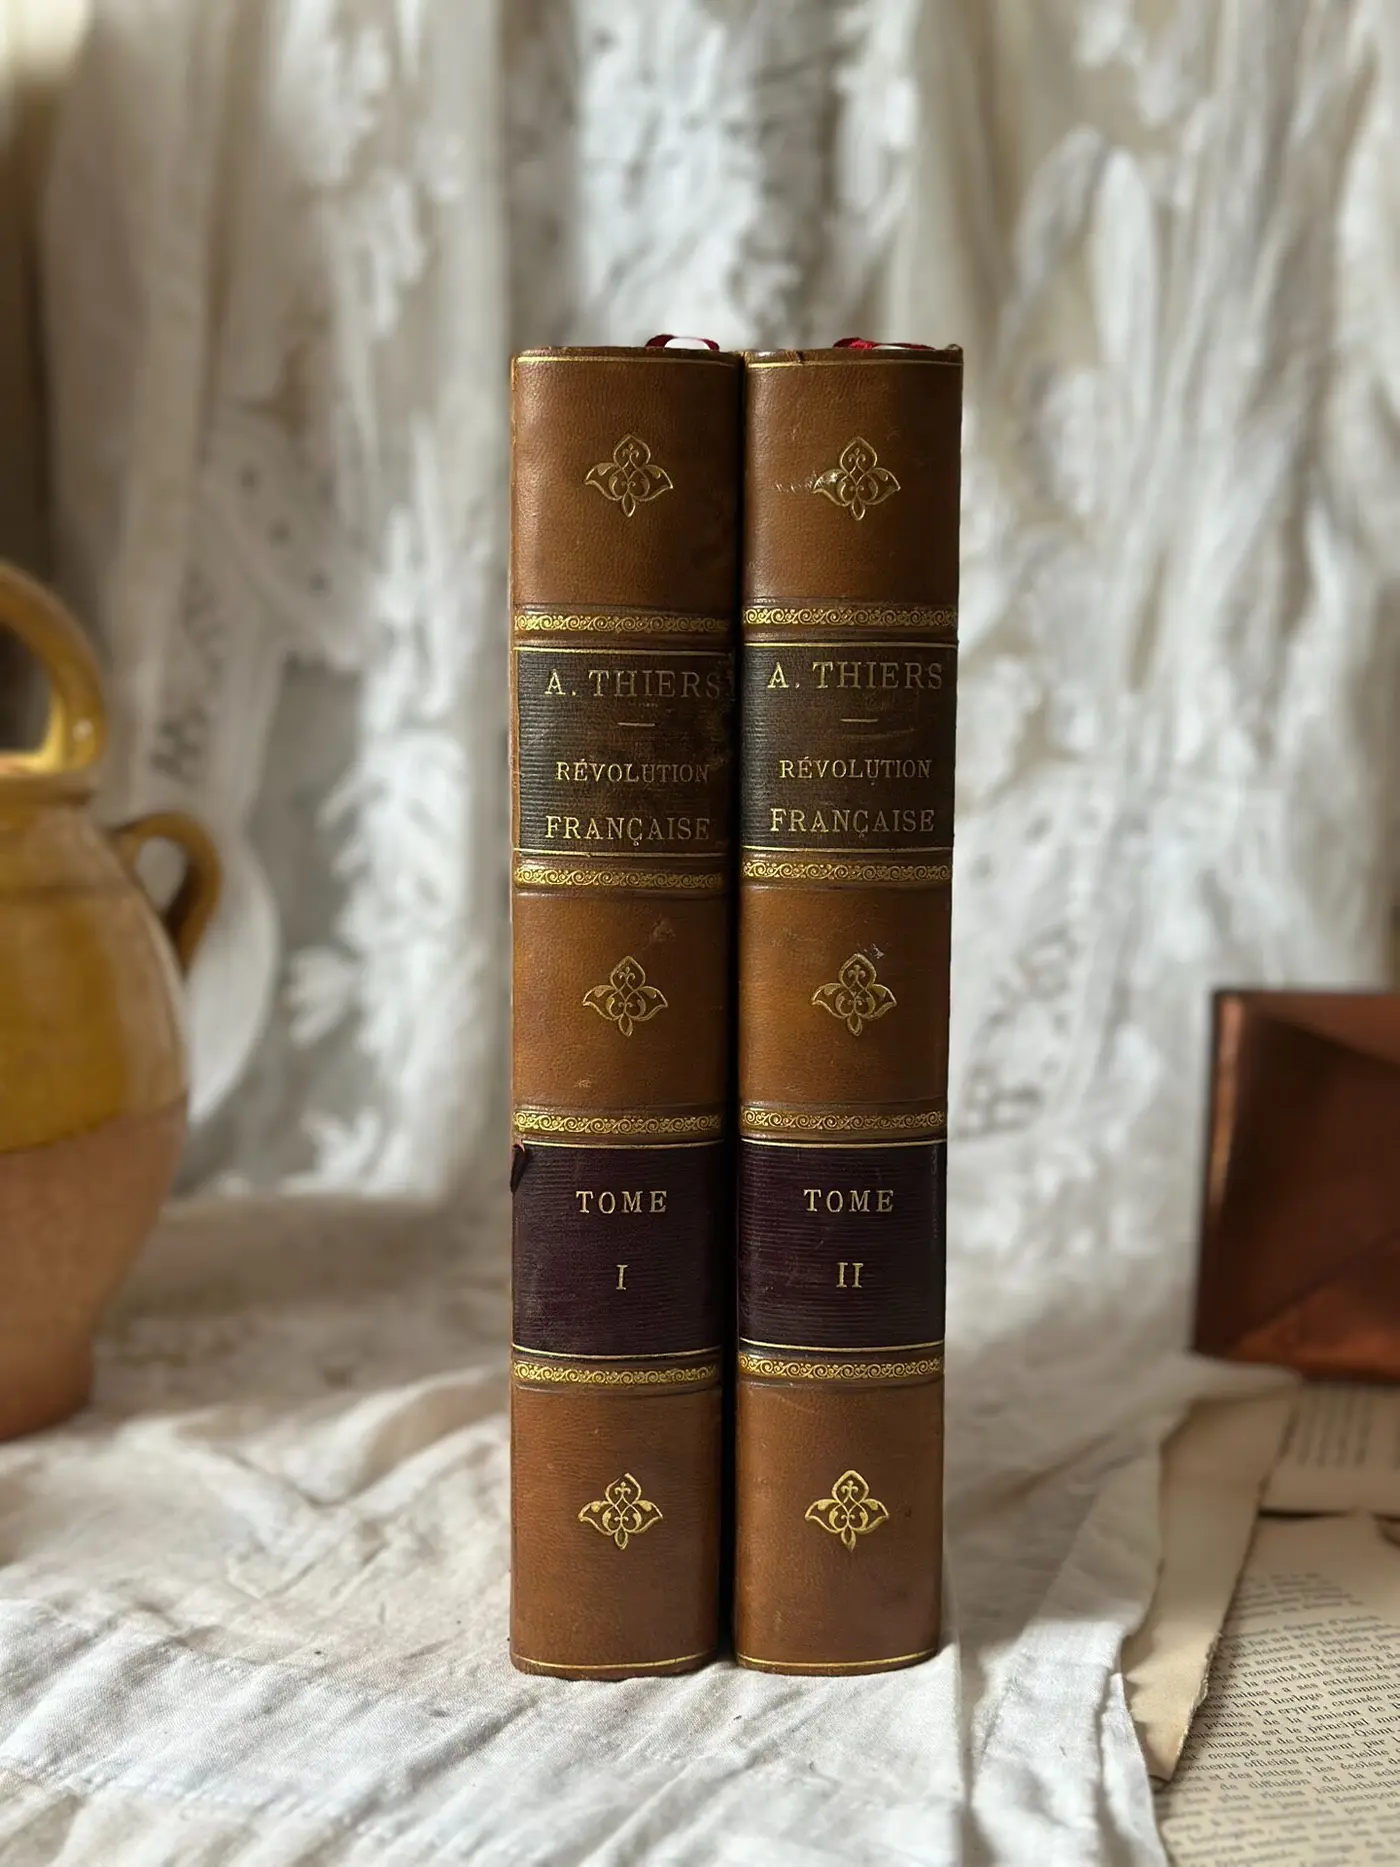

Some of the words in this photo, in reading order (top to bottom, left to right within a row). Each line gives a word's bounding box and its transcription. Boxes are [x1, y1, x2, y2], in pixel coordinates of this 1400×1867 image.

[545, 669, 577, 697] A.
[589, 669, 721, 699] THIERS
[768, 661, 801, 690] A.
[812, 661, 943, 690] THIERS
[556, 758, 710, 783] RÉVOLUTION
[780, 756, 931, 780] RÉVOLUTION
[545, 815, 710, 846] FRANÇAISE
[770, 807, 935, 838] FRANÇAISE
[575, 1190, 668, 1214] TOME
[804, 1189, 895, 1213] TOME
[615, 1264, 628, 1291] I
[836, 1262, 864, 1289] II
[1231, 1699, 1268, 1709] belle
[1269, 1692, 1324, 1705] horloge
[1332, 1694, 1383, 1707] creusée
[1203, 1720, 1254, 1730] princes
[1262, 1718, 1280, 1726] de
[1285, 1716, 1302, 1724] la
[1311, 1709, 1361, 1721] maison
[1367, 1705, 1386, 1713] de
[1261, 1728, 1282, 1736] est
[1285, 1726, 1302, 1734] le
[1306, 1717, 1370, 1734] principal
[1199, 1738, 1272, 1749] chancelier
[1276, 1737, 1295, 1745] de
[1207, 1749, 1259, 1760] occupé
[1264, 1742, 1356, 1756] actuellement
[1361, 1739, 1386, 1749] par
[1243, 1757, 1300, 1768] officiels
[1304, 1755, 1324, 1763] de
[1324, 1753, 1343, 1761] la
[1344, 1749, 1390, 1759] vieille
